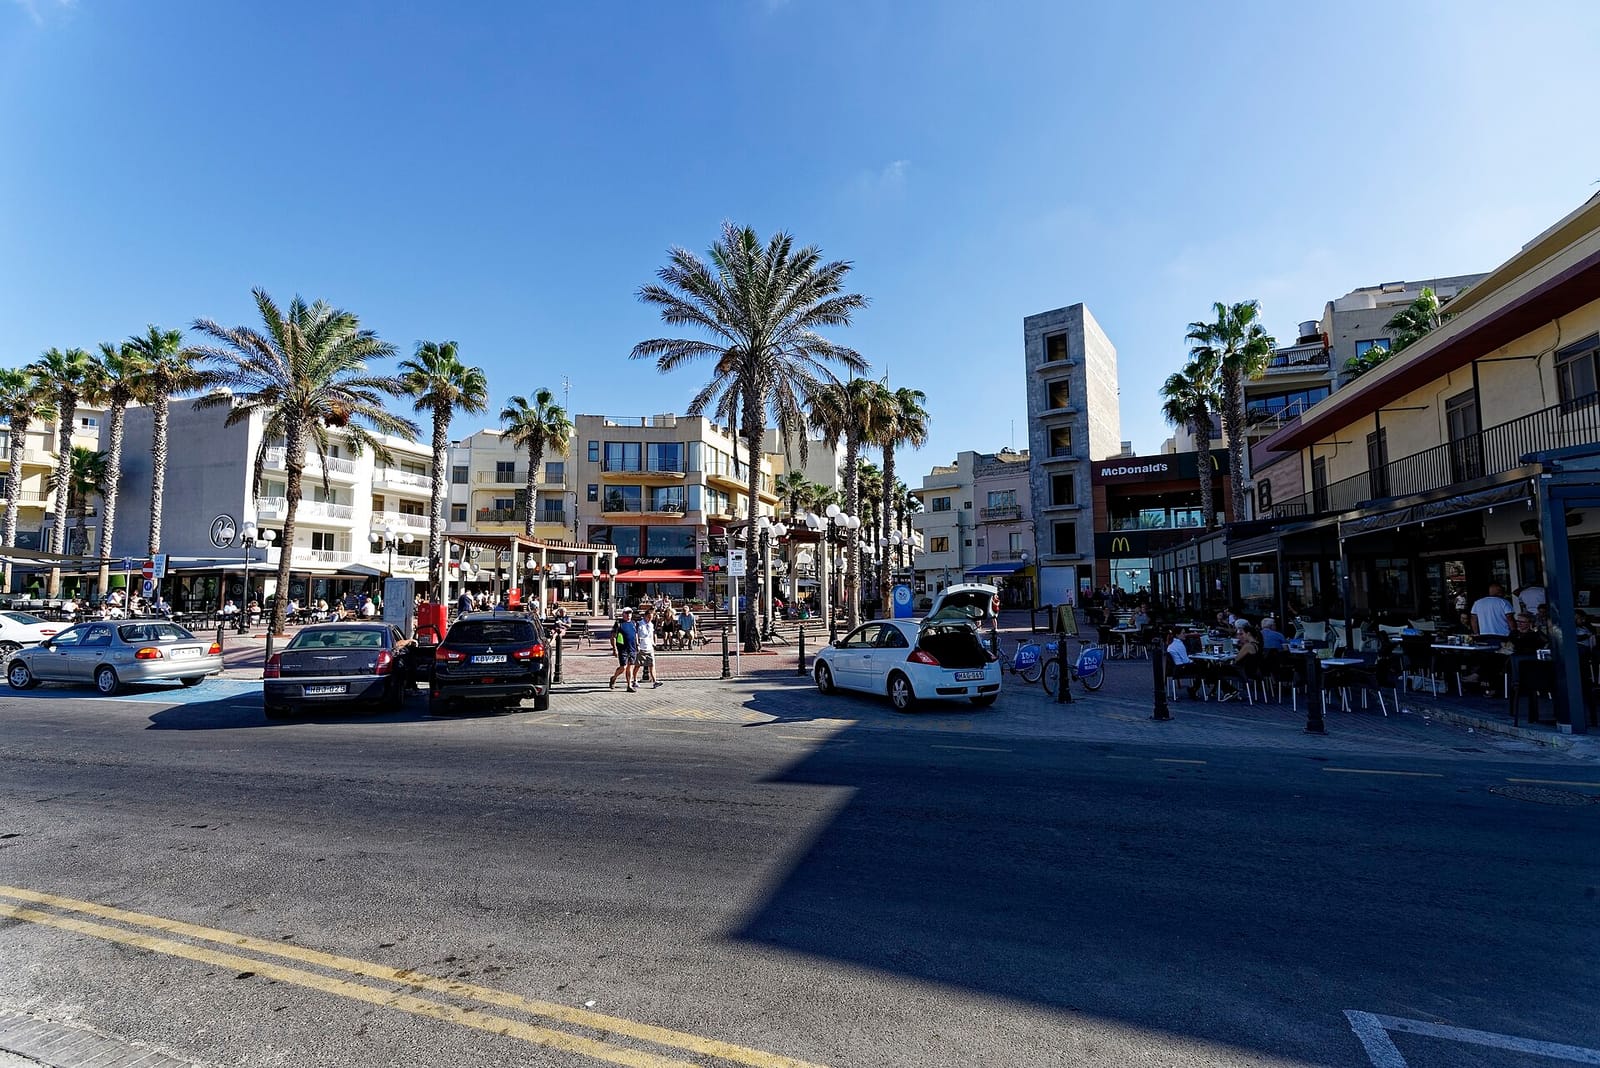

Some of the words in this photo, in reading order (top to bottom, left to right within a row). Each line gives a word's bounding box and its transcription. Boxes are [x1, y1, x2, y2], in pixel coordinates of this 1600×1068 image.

[1101, 463, 1168, 477] McDonald's
[1258, 478, 1272, 513] B
[634, 557, 653, 565] Pizza
